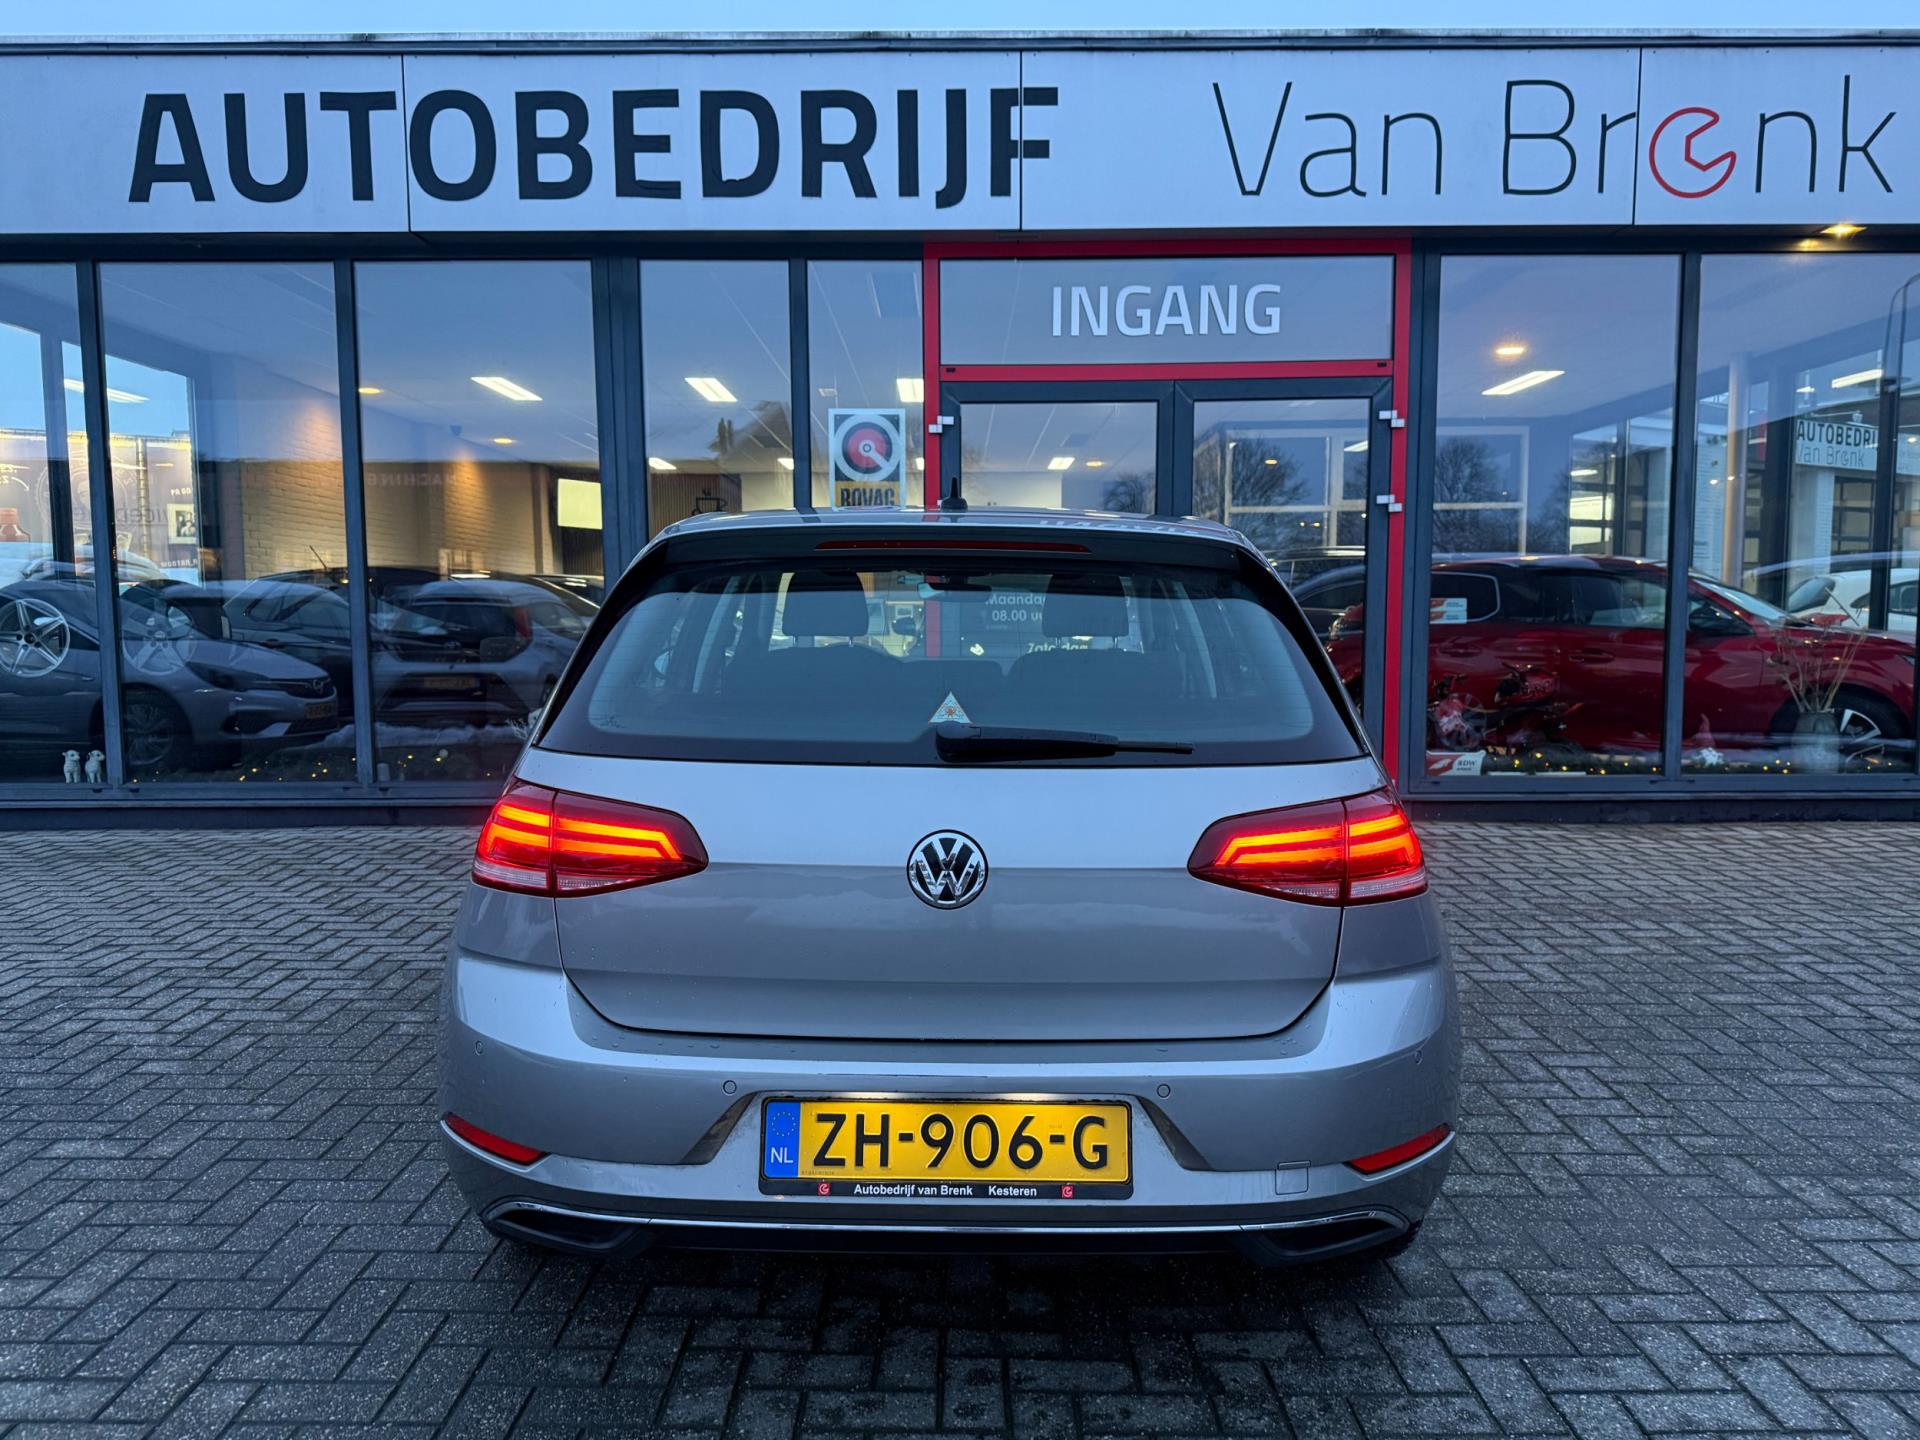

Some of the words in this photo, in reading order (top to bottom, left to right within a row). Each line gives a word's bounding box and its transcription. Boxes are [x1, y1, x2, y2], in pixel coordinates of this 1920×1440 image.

[128, 87, 1059, 208] AUTOBEDRIJF
[1212, 82, 1441, 197] Van
[1502, 75, 1896, 198] Brenk
[1052, 283, 1281, 337] INGANG
[992, 610, 1027, 622] 08.00
[770, 1147, 794, 1164] NL
[813, 1113, 1108, 1169] ZH-906-G
[854, 1184, 914, 1197] Autobedrijf
[918, 1187, 937, 1195] van
[940, 1185, 973, 1196] Brenk
[988, 1186, 1037, 1197] Kesteren
